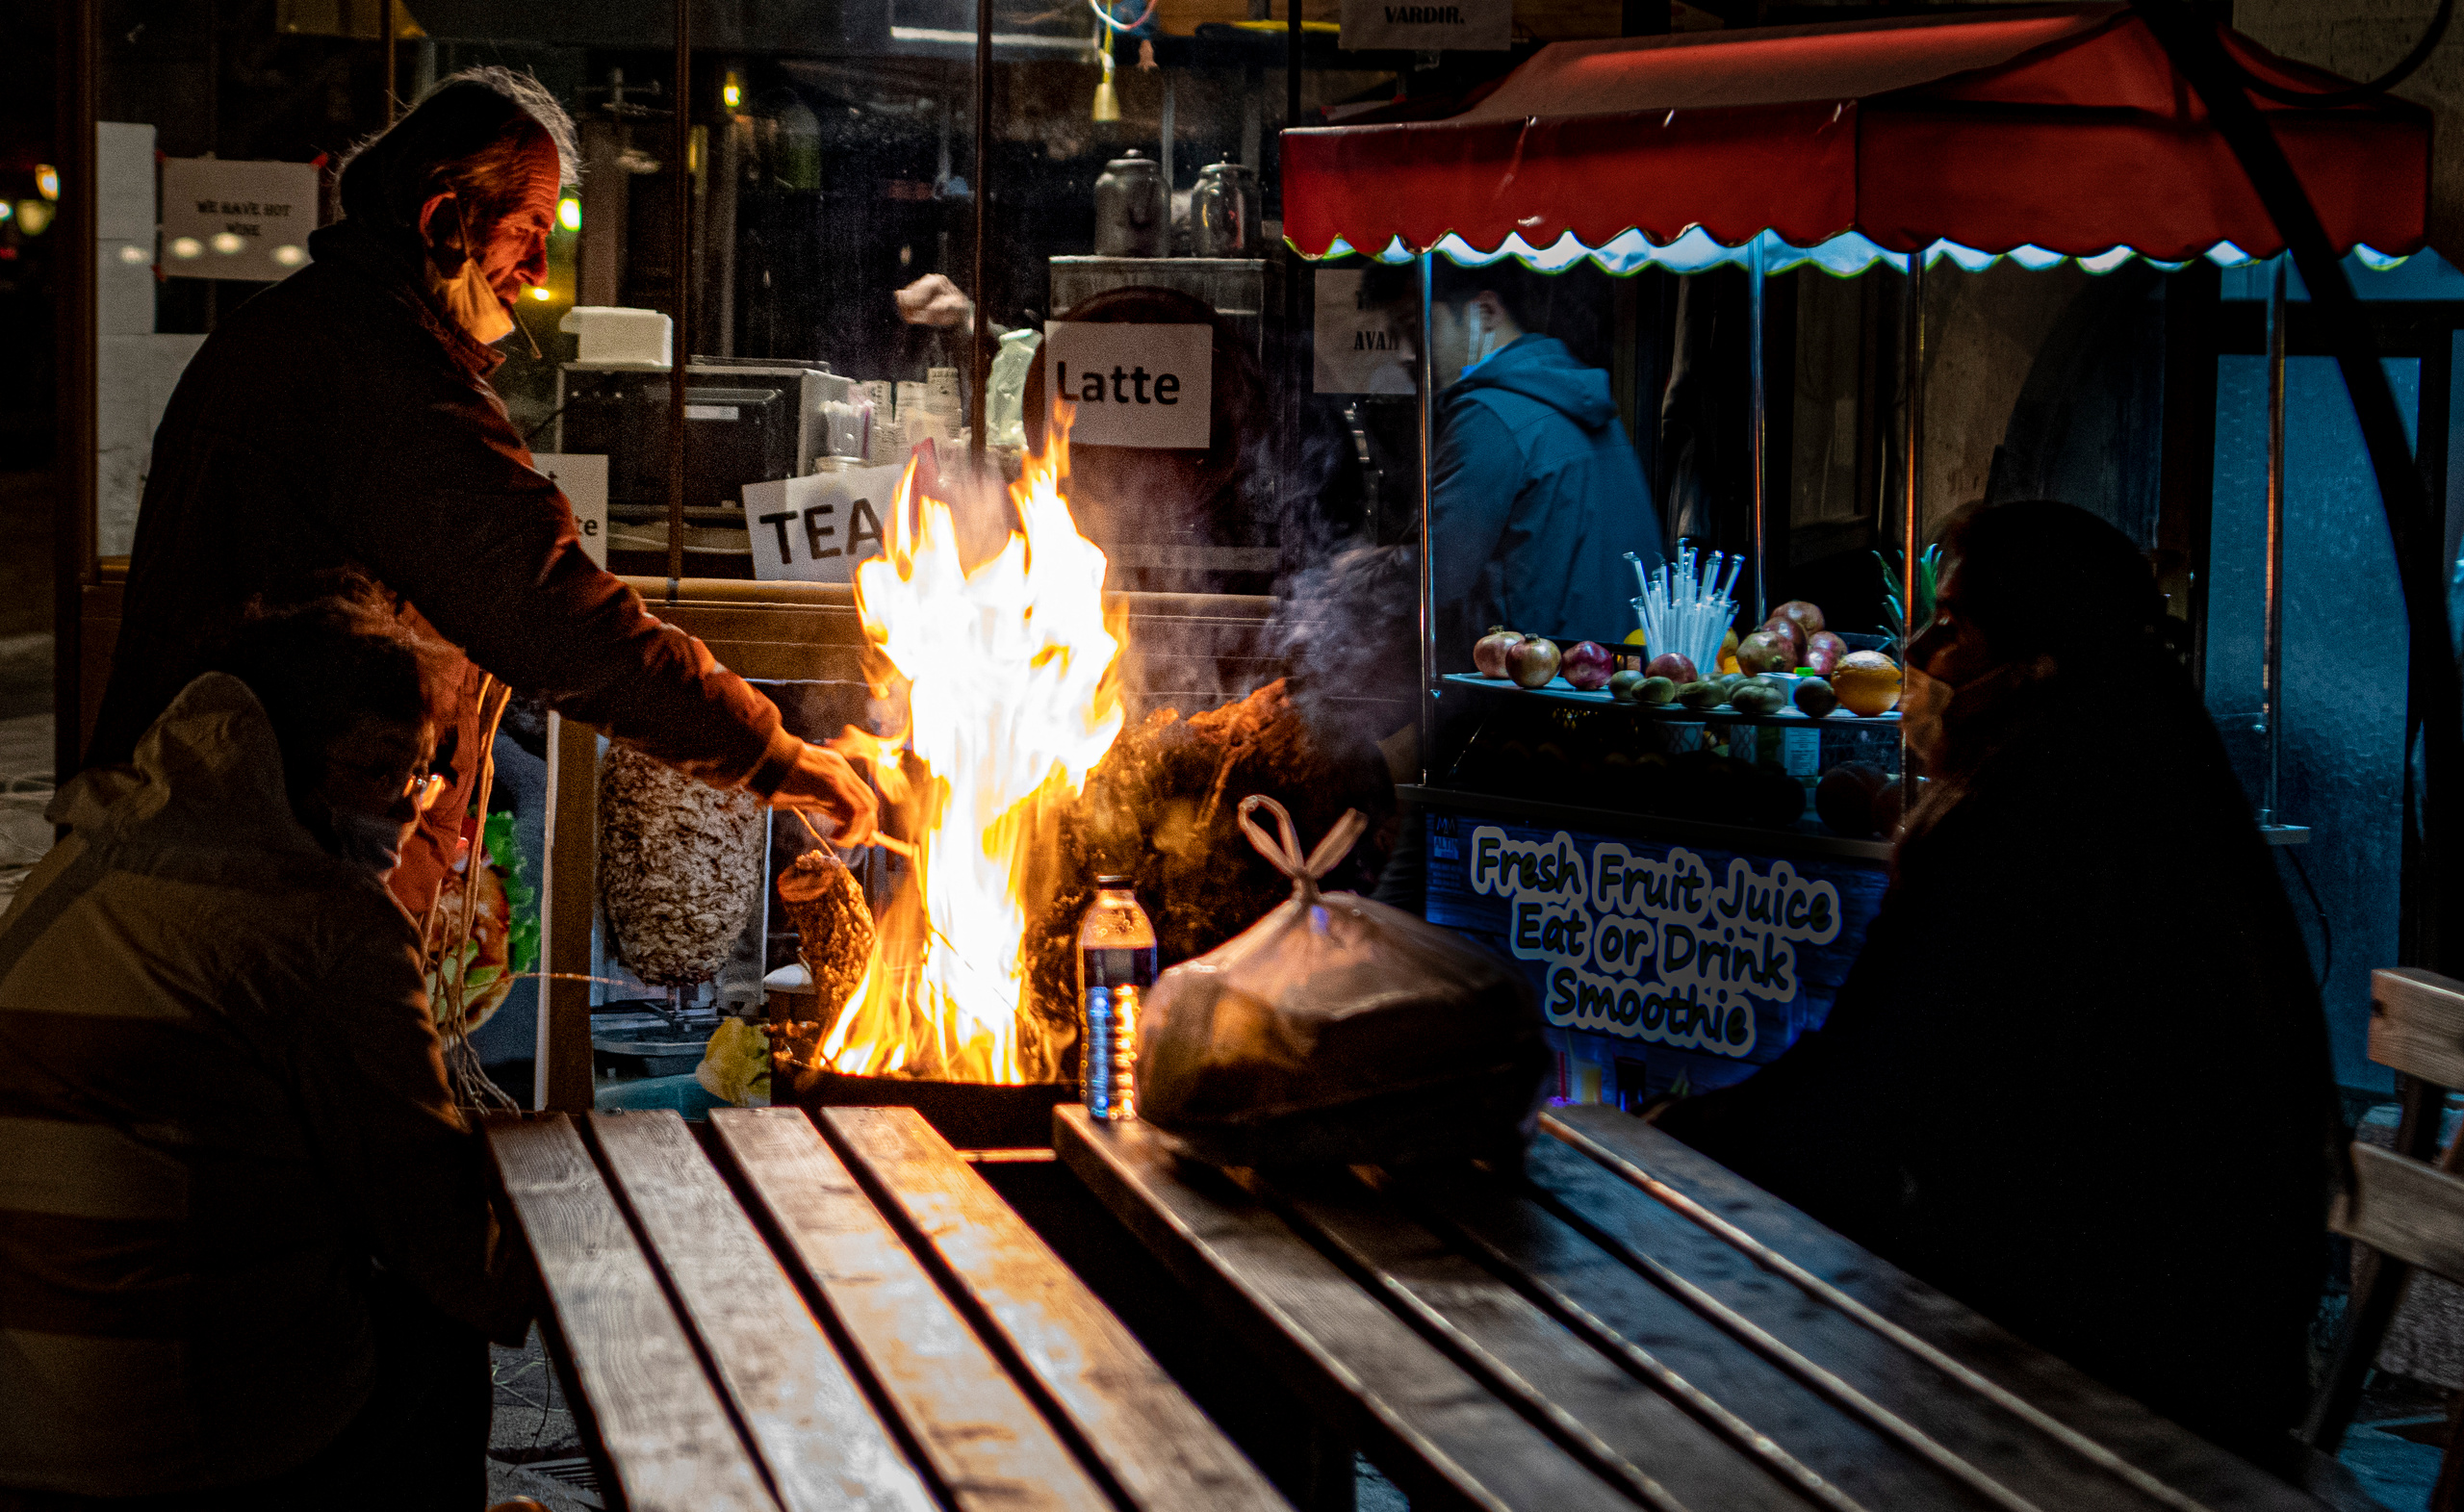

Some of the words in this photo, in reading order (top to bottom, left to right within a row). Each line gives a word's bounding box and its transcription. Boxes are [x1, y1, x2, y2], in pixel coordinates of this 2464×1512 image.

[1385, 6, 1465, 24] VARDIR.
[1057, 361, 1180, 405] Latte
[758, 497, 885, 565] TEA
[1476, 836, 1582, 896] Fresh
[1598, 853, 1706, 913] Fruit
[1716, 868, 1832, 934] Juice
[1516, 902, 1586, 957] Eat
[1599, 924, 1650, 967] or
[1662, 924, 1789, 992] Drink
[1550, 965, 1750, 1047] Smoothie
